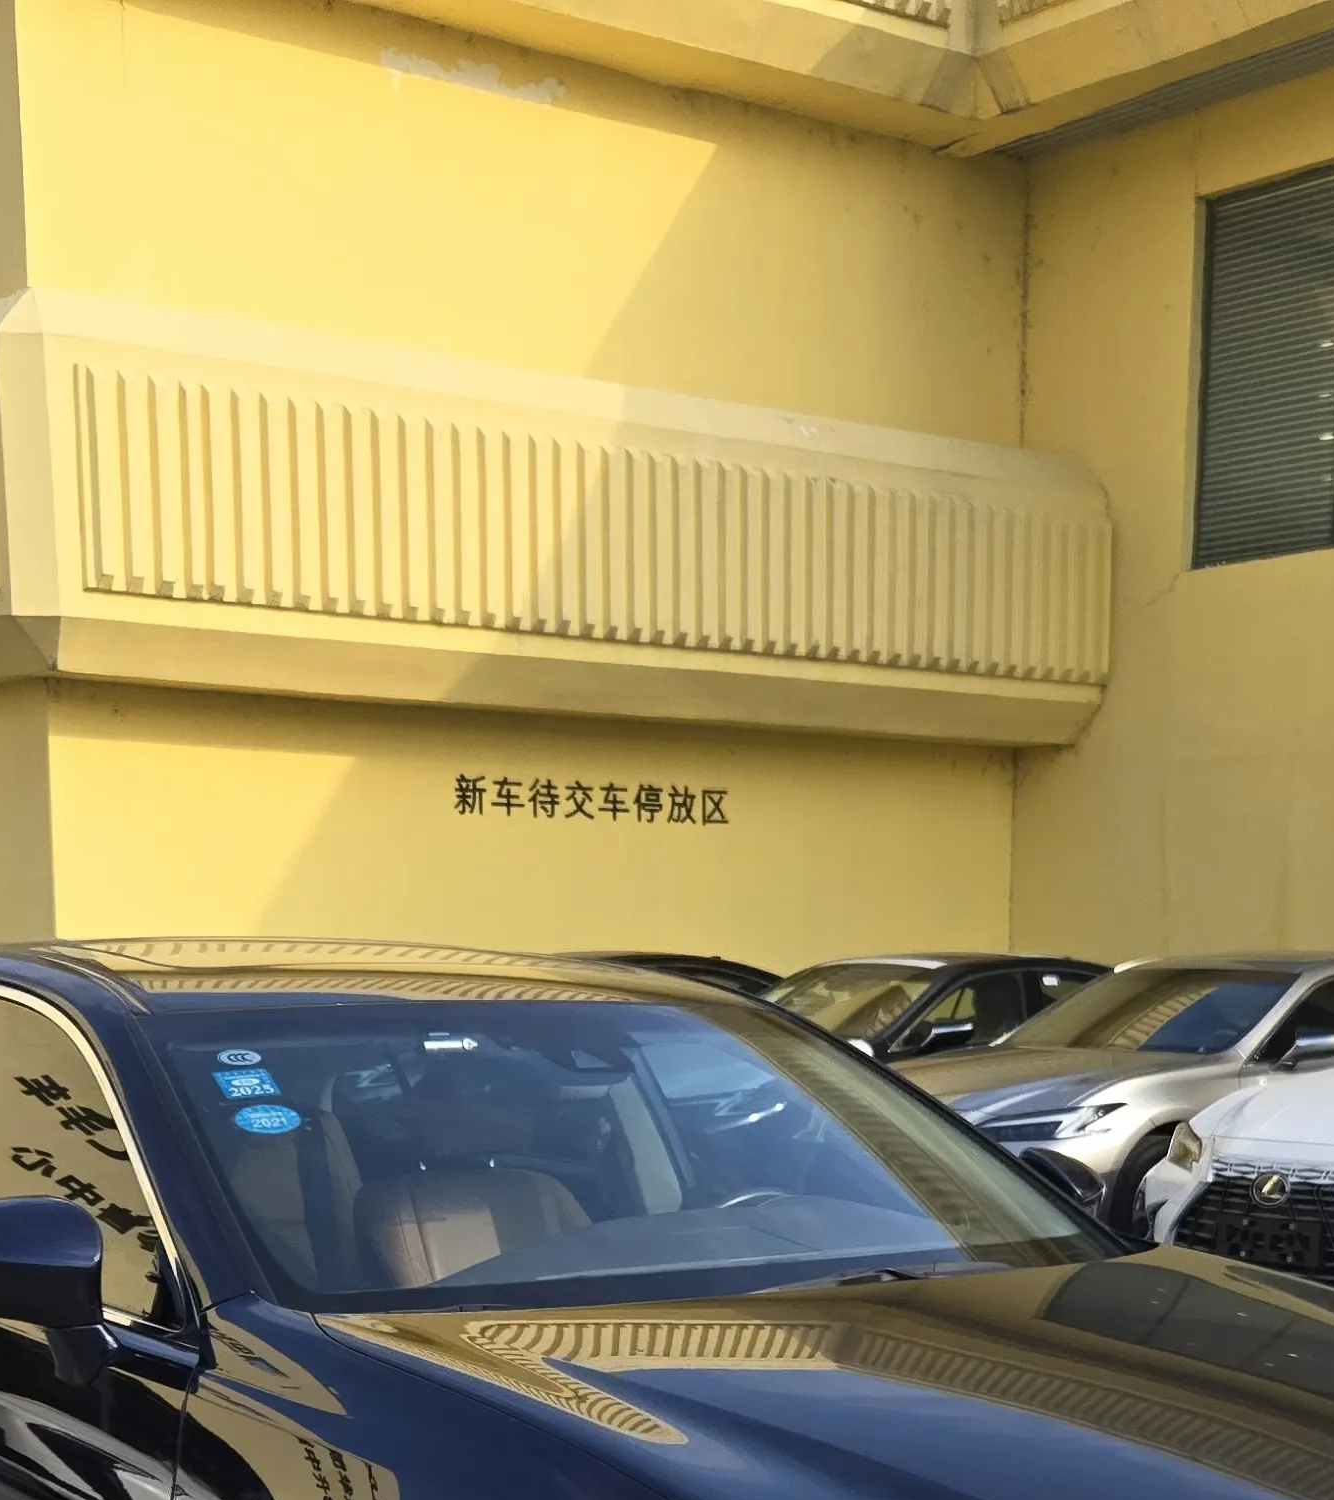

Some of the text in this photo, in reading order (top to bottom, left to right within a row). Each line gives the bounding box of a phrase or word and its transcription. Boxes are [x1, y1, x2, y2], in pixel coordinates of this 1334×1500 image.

[453, 773, 730, 826] 新车待交车停放区
[229, 1084, 275, 1097] 2025
[251, 1117, 288, 1129] 2021
